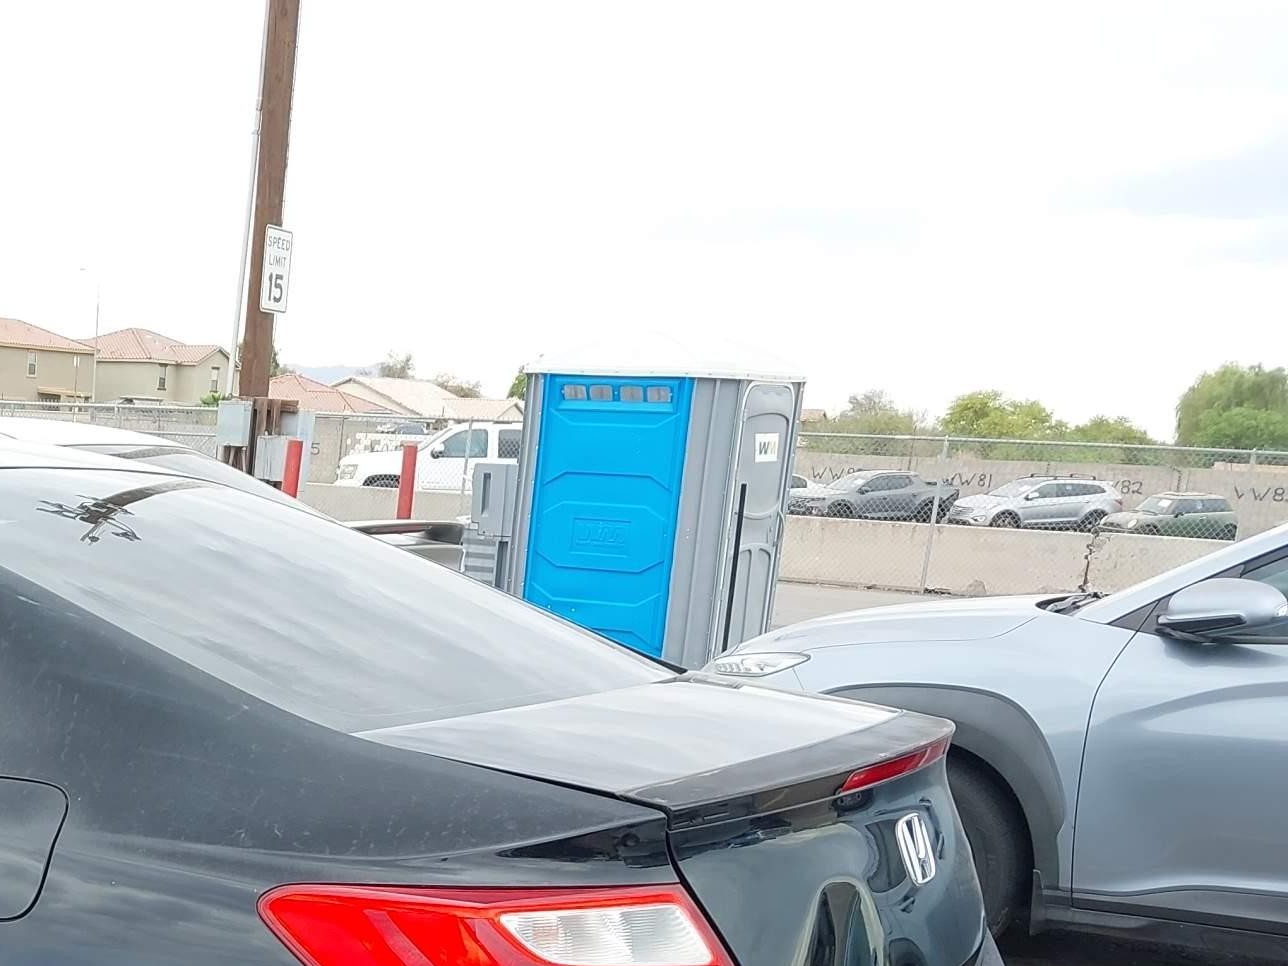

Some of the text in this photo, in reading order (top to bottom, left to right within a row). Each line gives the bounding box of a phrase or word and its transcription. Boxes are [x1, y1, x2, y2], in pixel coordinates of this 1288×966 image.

[268, 236, 290, 251] SPEED
[268, 254, 286, 268] LIMIT
[268, 272, 283, 303] 15
